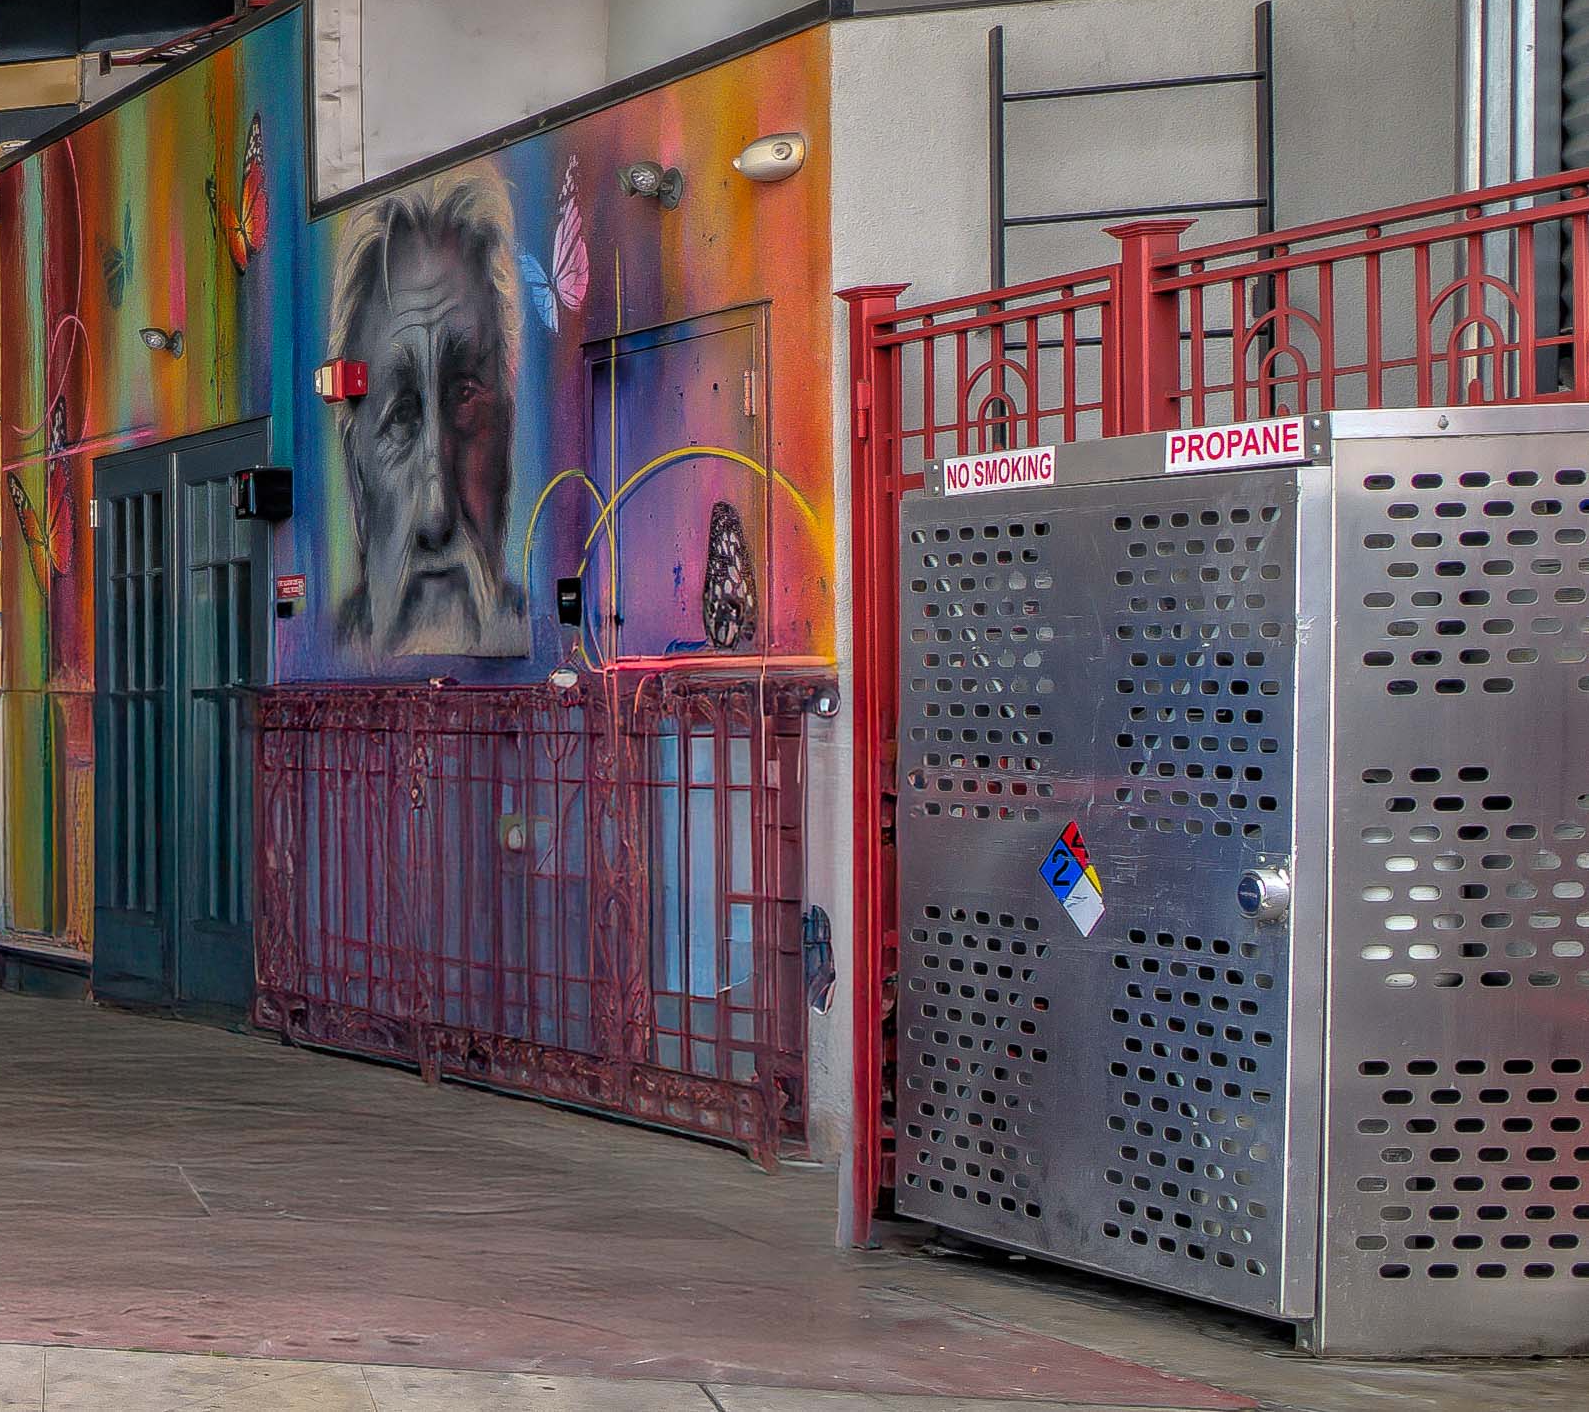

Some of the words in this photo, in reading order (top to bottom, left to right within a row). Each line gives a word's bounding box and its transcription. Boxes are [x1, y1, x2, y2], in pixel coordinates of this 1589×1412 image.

[1170, 422, 1300, 464] PROPANE
[946, 462, 970, 490] NO
[974, 452, 1052, 487] SMOKING
[1052, 849, 1070, 887] 2
